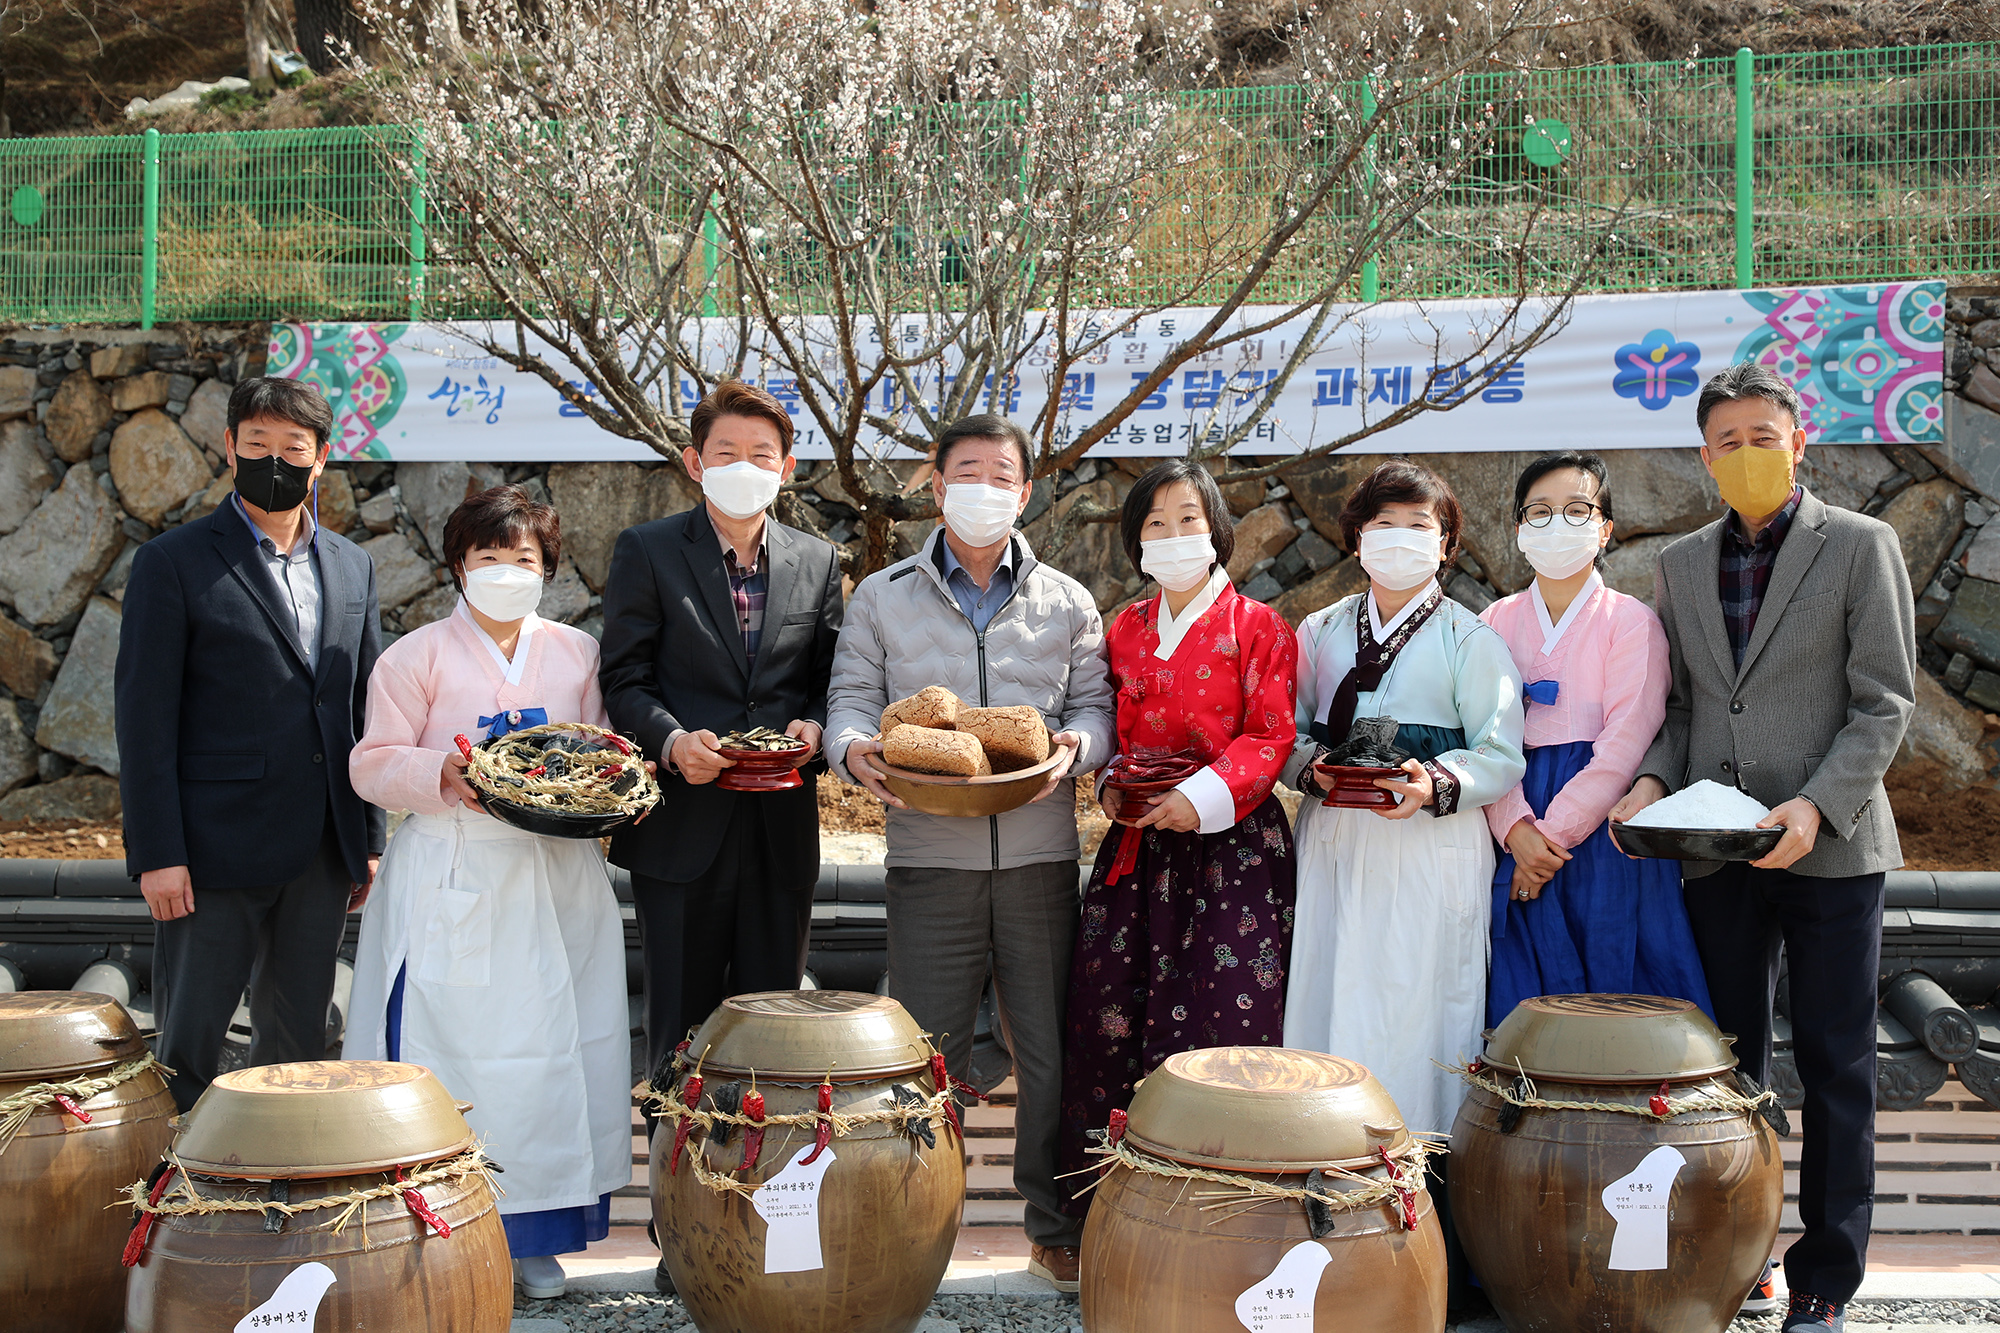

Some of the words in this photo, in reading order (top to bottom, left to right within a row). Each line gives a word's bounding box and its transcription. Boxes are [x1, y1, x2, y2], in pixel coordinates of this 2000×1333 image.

[1058, 371, 1095, 411] 및
[1628, 1183, 1653, 1192] 전통장
[1265, 1287, 1295, 1299] 전통장
[250, 1309, 308, 1328] 상황버섯장
